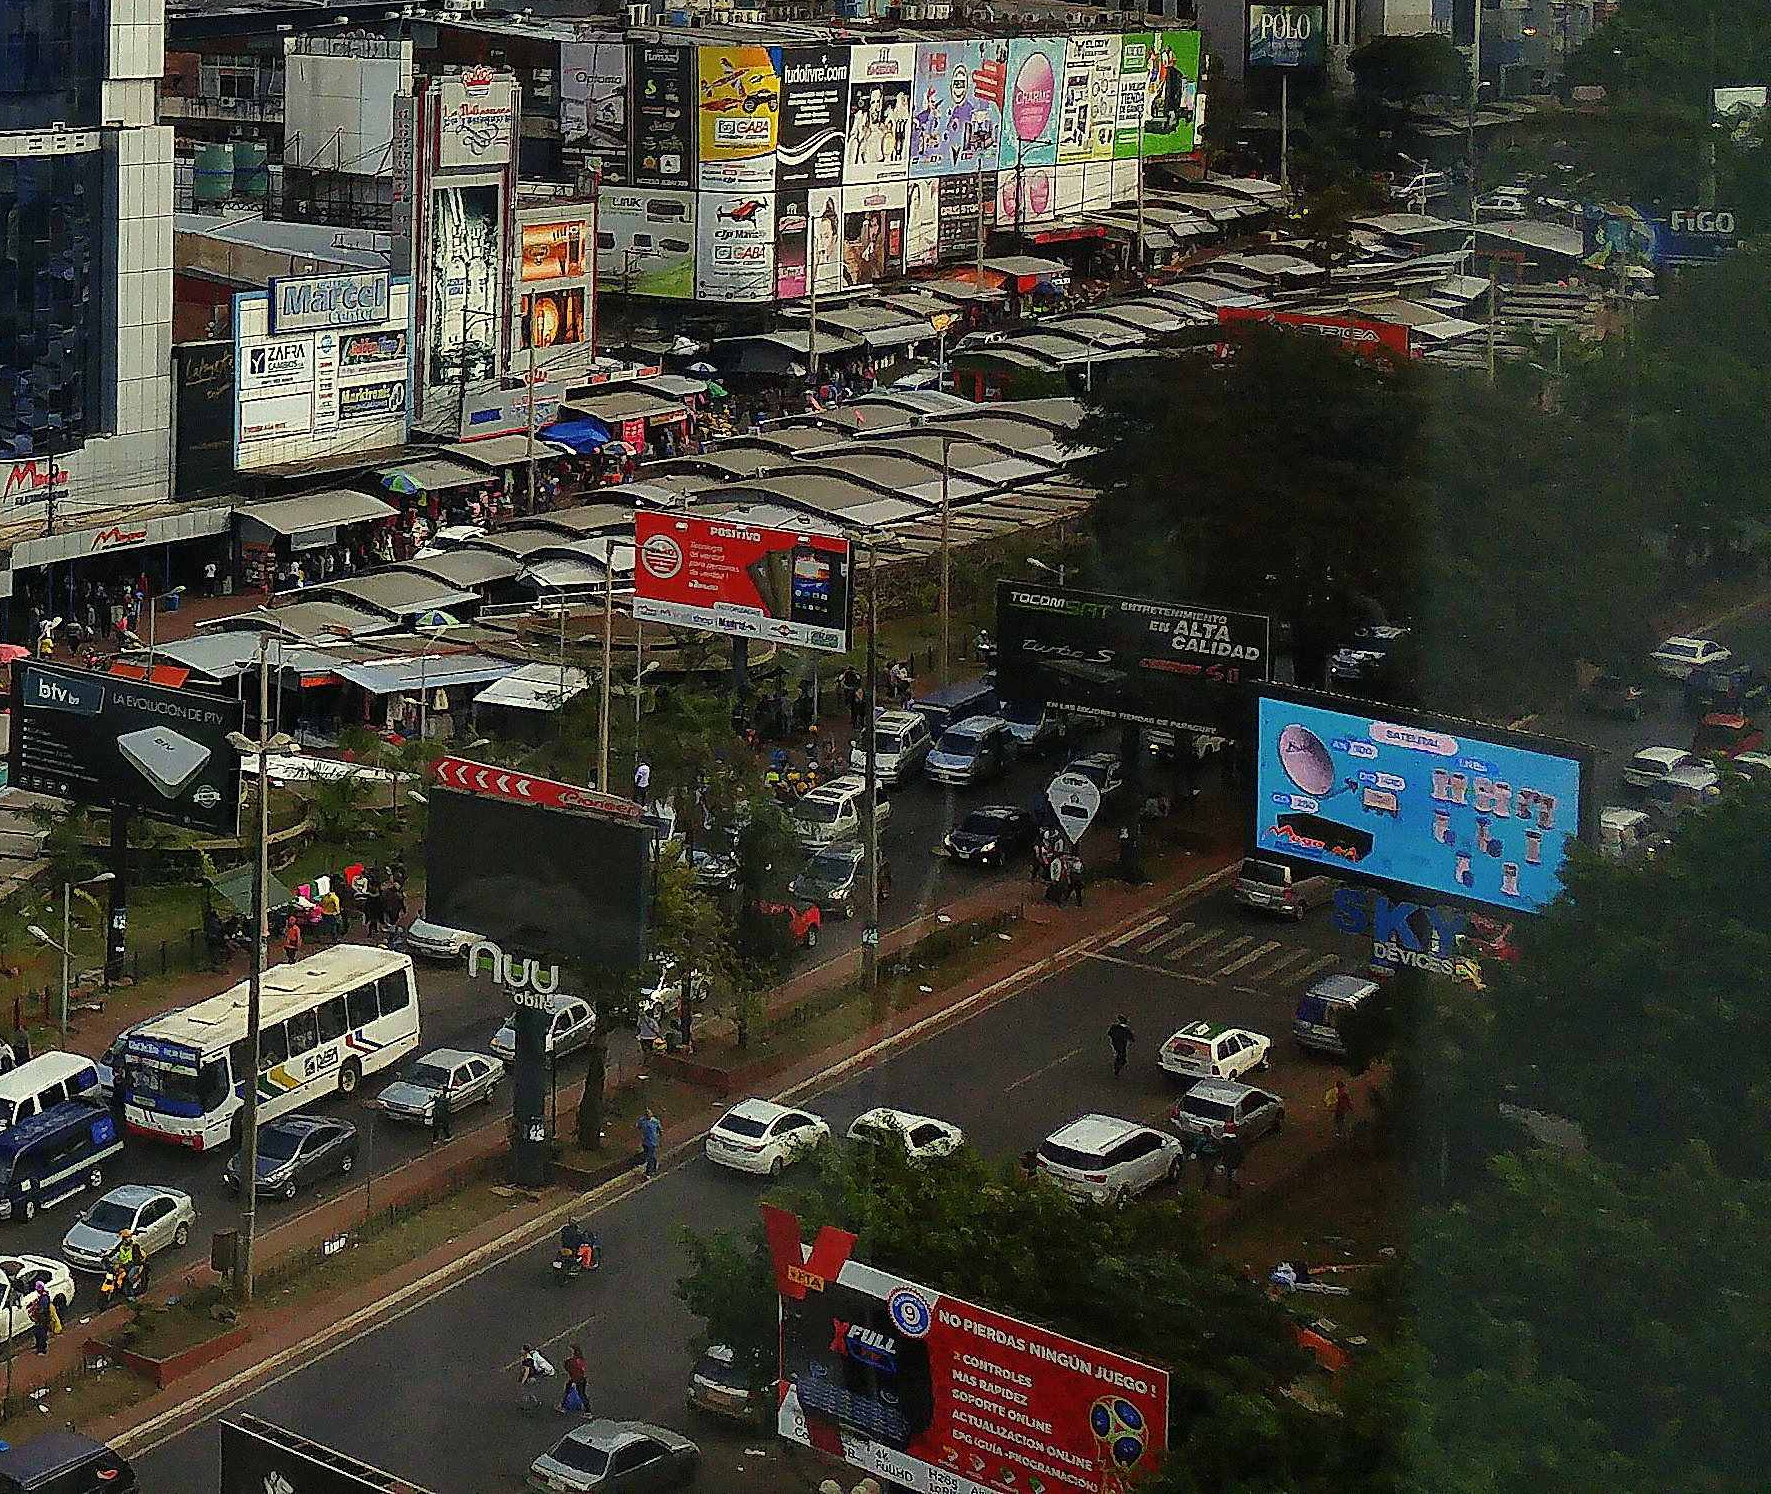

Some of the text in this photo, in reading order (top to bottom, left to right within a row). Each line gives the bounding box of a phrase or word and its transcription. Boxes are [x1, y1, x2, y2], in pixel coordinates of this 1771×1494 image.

[283, 279, 384, 315] Marcel
[1121, 602, 1228, 624] ENTRETENIMIENTO
[1172, 621, 1231, 643] ALTA
[1171, 635, 1260, 662] CALIDAD
[1373, 942, 1454, 976] DEVICES
[939, 1309, 961, 1329] NO
[964, 1317, 1027, 1353] PIERDAS
[1029, 1344, 1094, 1377] NINGÚN
[1095, 1366, 1147, 1394] JUEGO
[962, 1355, 1033, 1388] CONTROLES
[979, 1378, 1029, 1407] RAPIDEZ
[952, 1388, 1053, 1436] SOPORTE ONLINE
[1046, 1444, 1094, 1472] ONLINE
